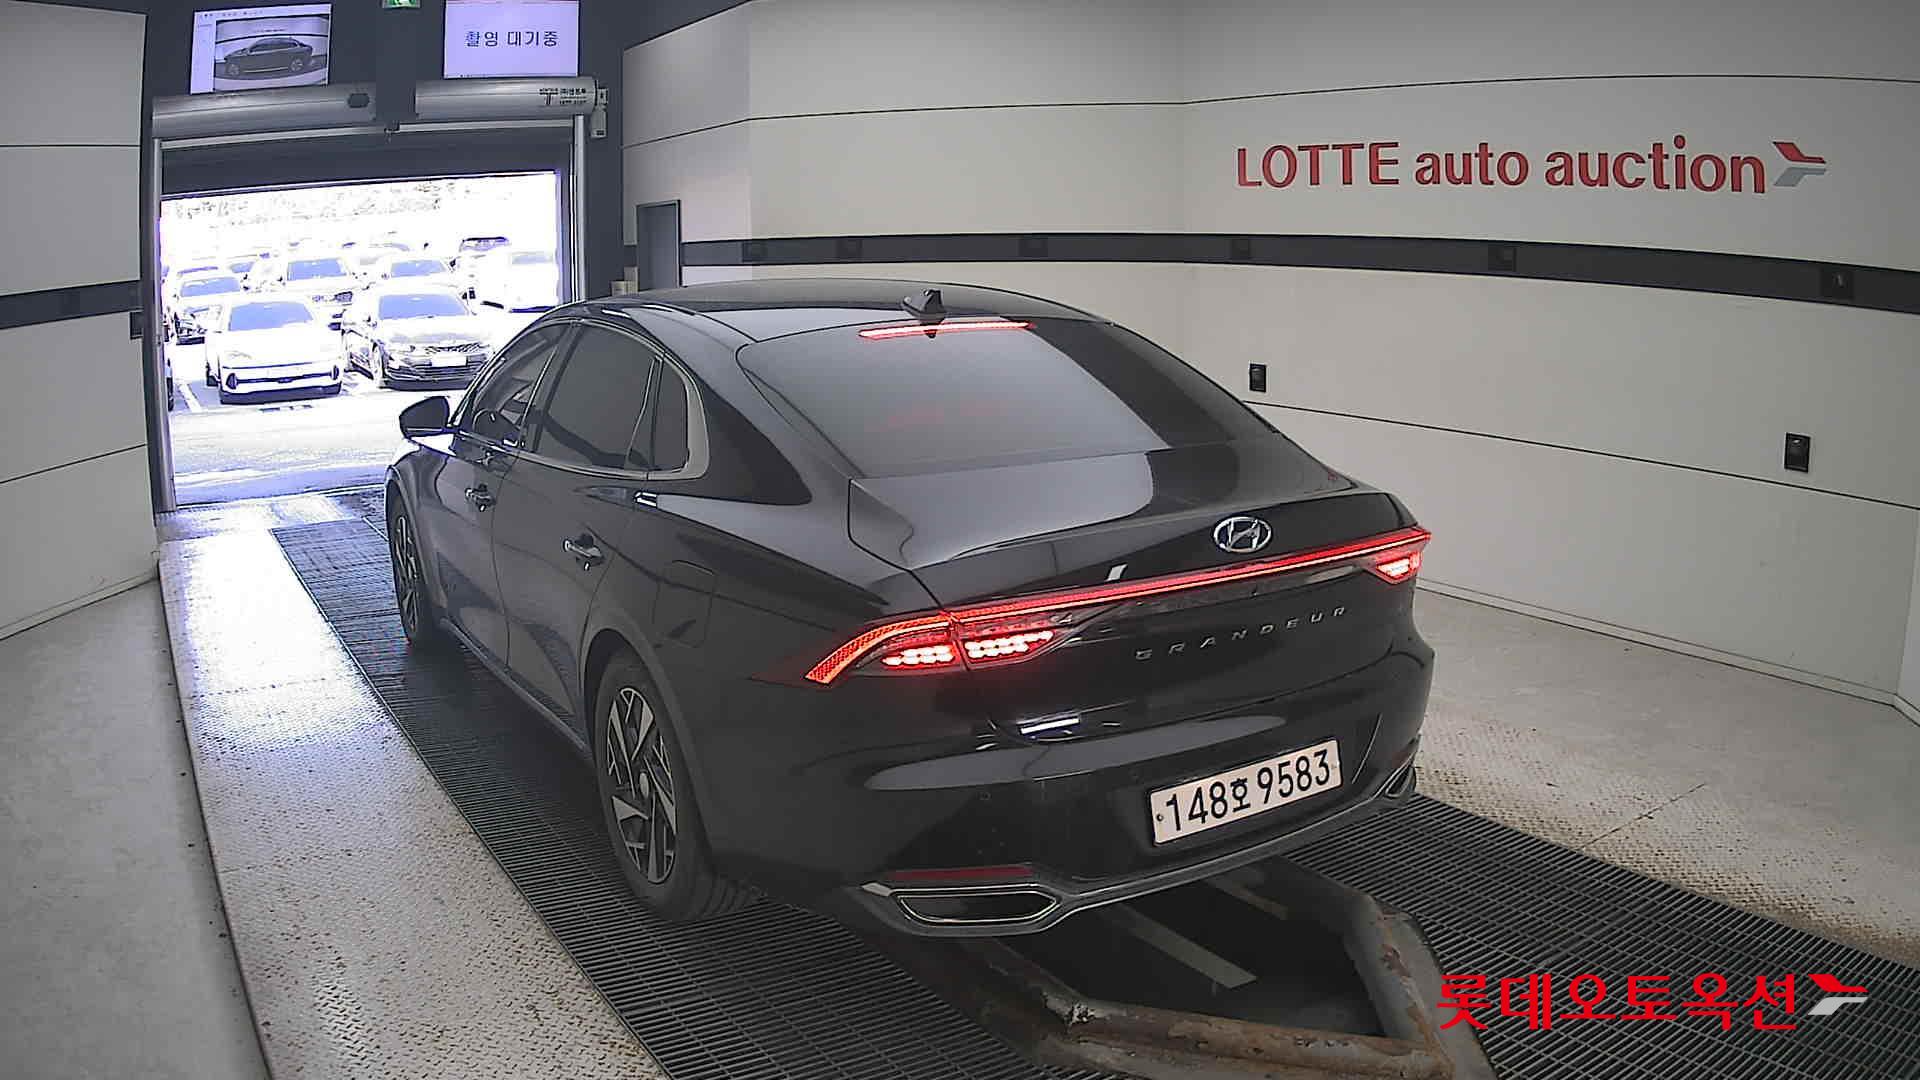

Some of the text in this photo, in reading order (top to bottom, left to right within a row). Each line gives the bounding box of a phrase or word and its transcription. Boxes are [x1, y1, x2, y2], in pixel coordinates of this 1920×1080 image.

[507, 31, 559, 48] 대기중
[1237, 135, 1766, 194] LOTTE auto auction
[1135, 606, 1347, 661] GRANDEUR
[1165, 749, 1331, 832] 148호 9583
